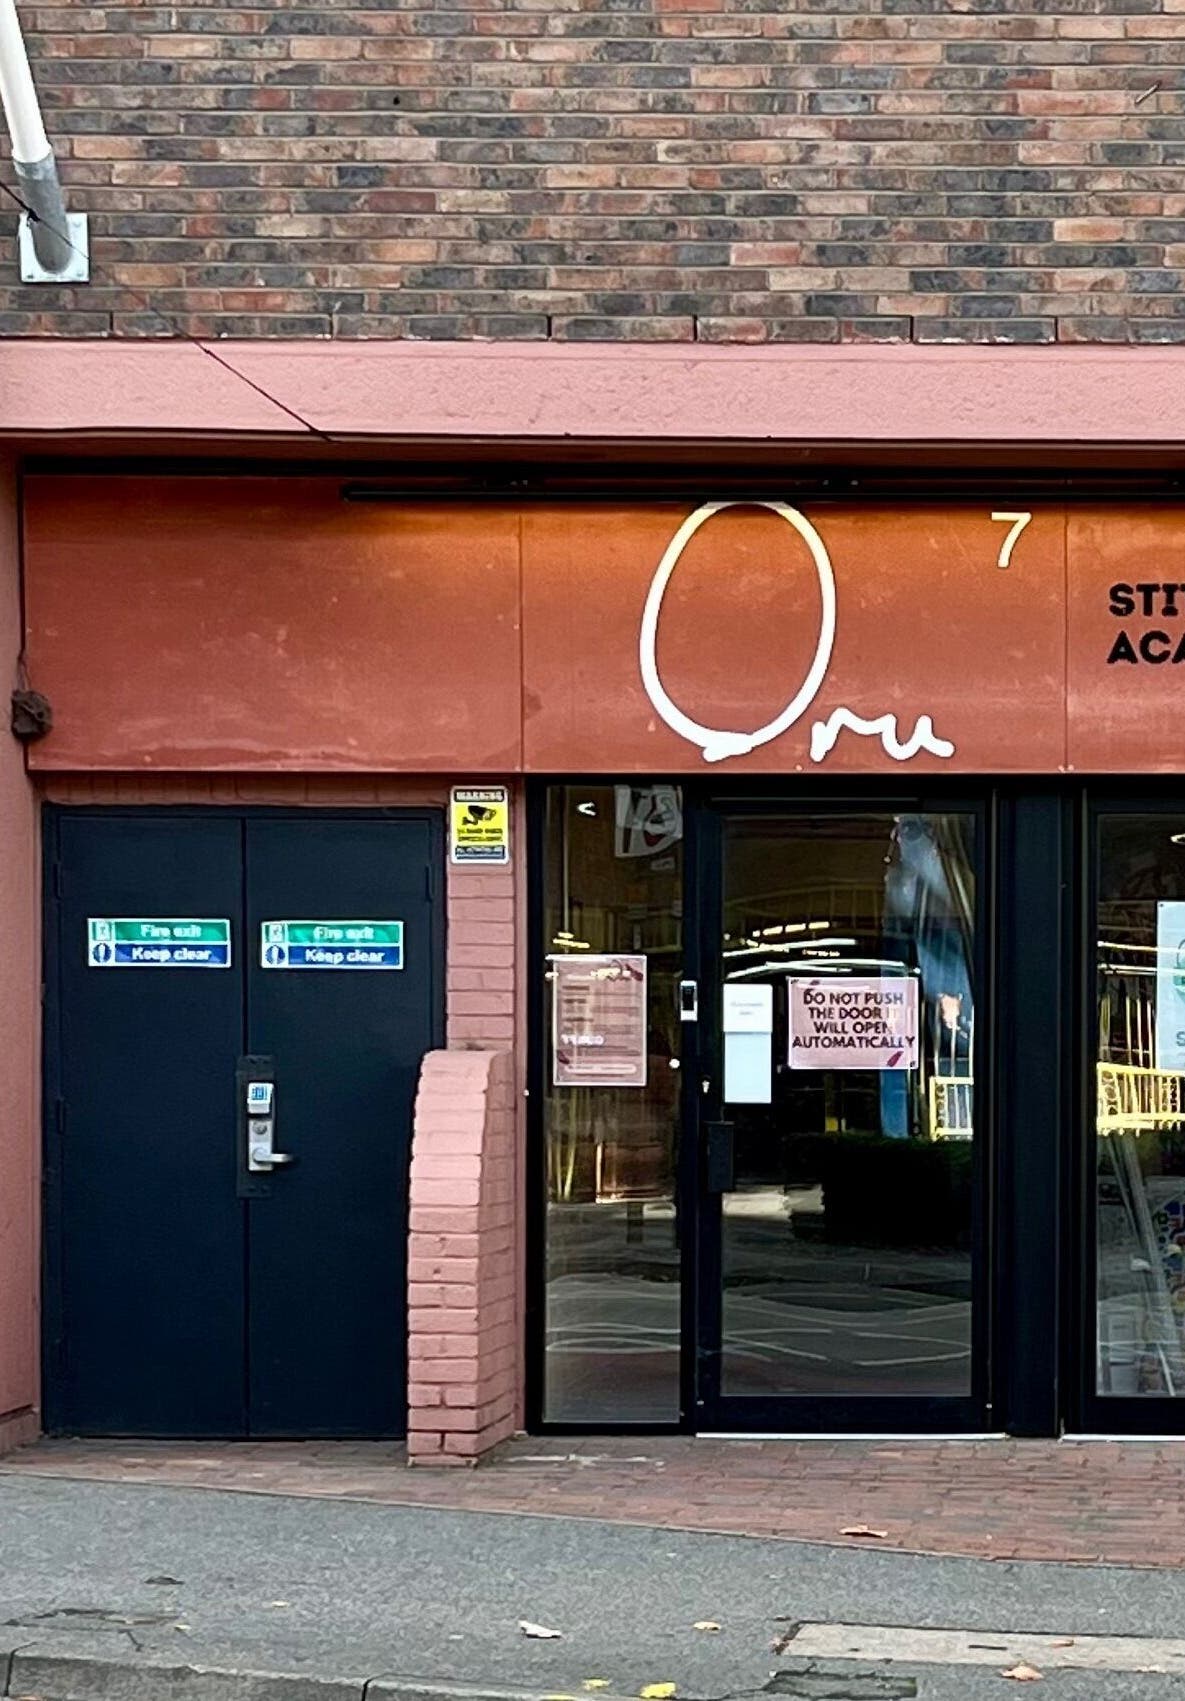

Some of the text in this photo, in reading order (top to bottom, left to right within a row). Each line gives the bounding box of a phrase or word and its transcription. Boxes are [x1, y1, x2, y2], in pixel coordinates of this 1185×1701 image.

[991, 512, 1032, 568] 7
[140, 924, 202, 938] Fire exit
[313, 926, 375, 940] Fire exit
[132, 946, 212, 962] Keep clear
[305, 949, 386, 964] Keep clear
[803, 989, 905, 1006] DO NOT PUSH
[808, 1007, 835, 1020] THE
[839, 1007, 883, 1020] DOOR
[813, 1021, 849, 1034] WILL
[792, 1036, 916, 1049] AUTOMATICALLY
